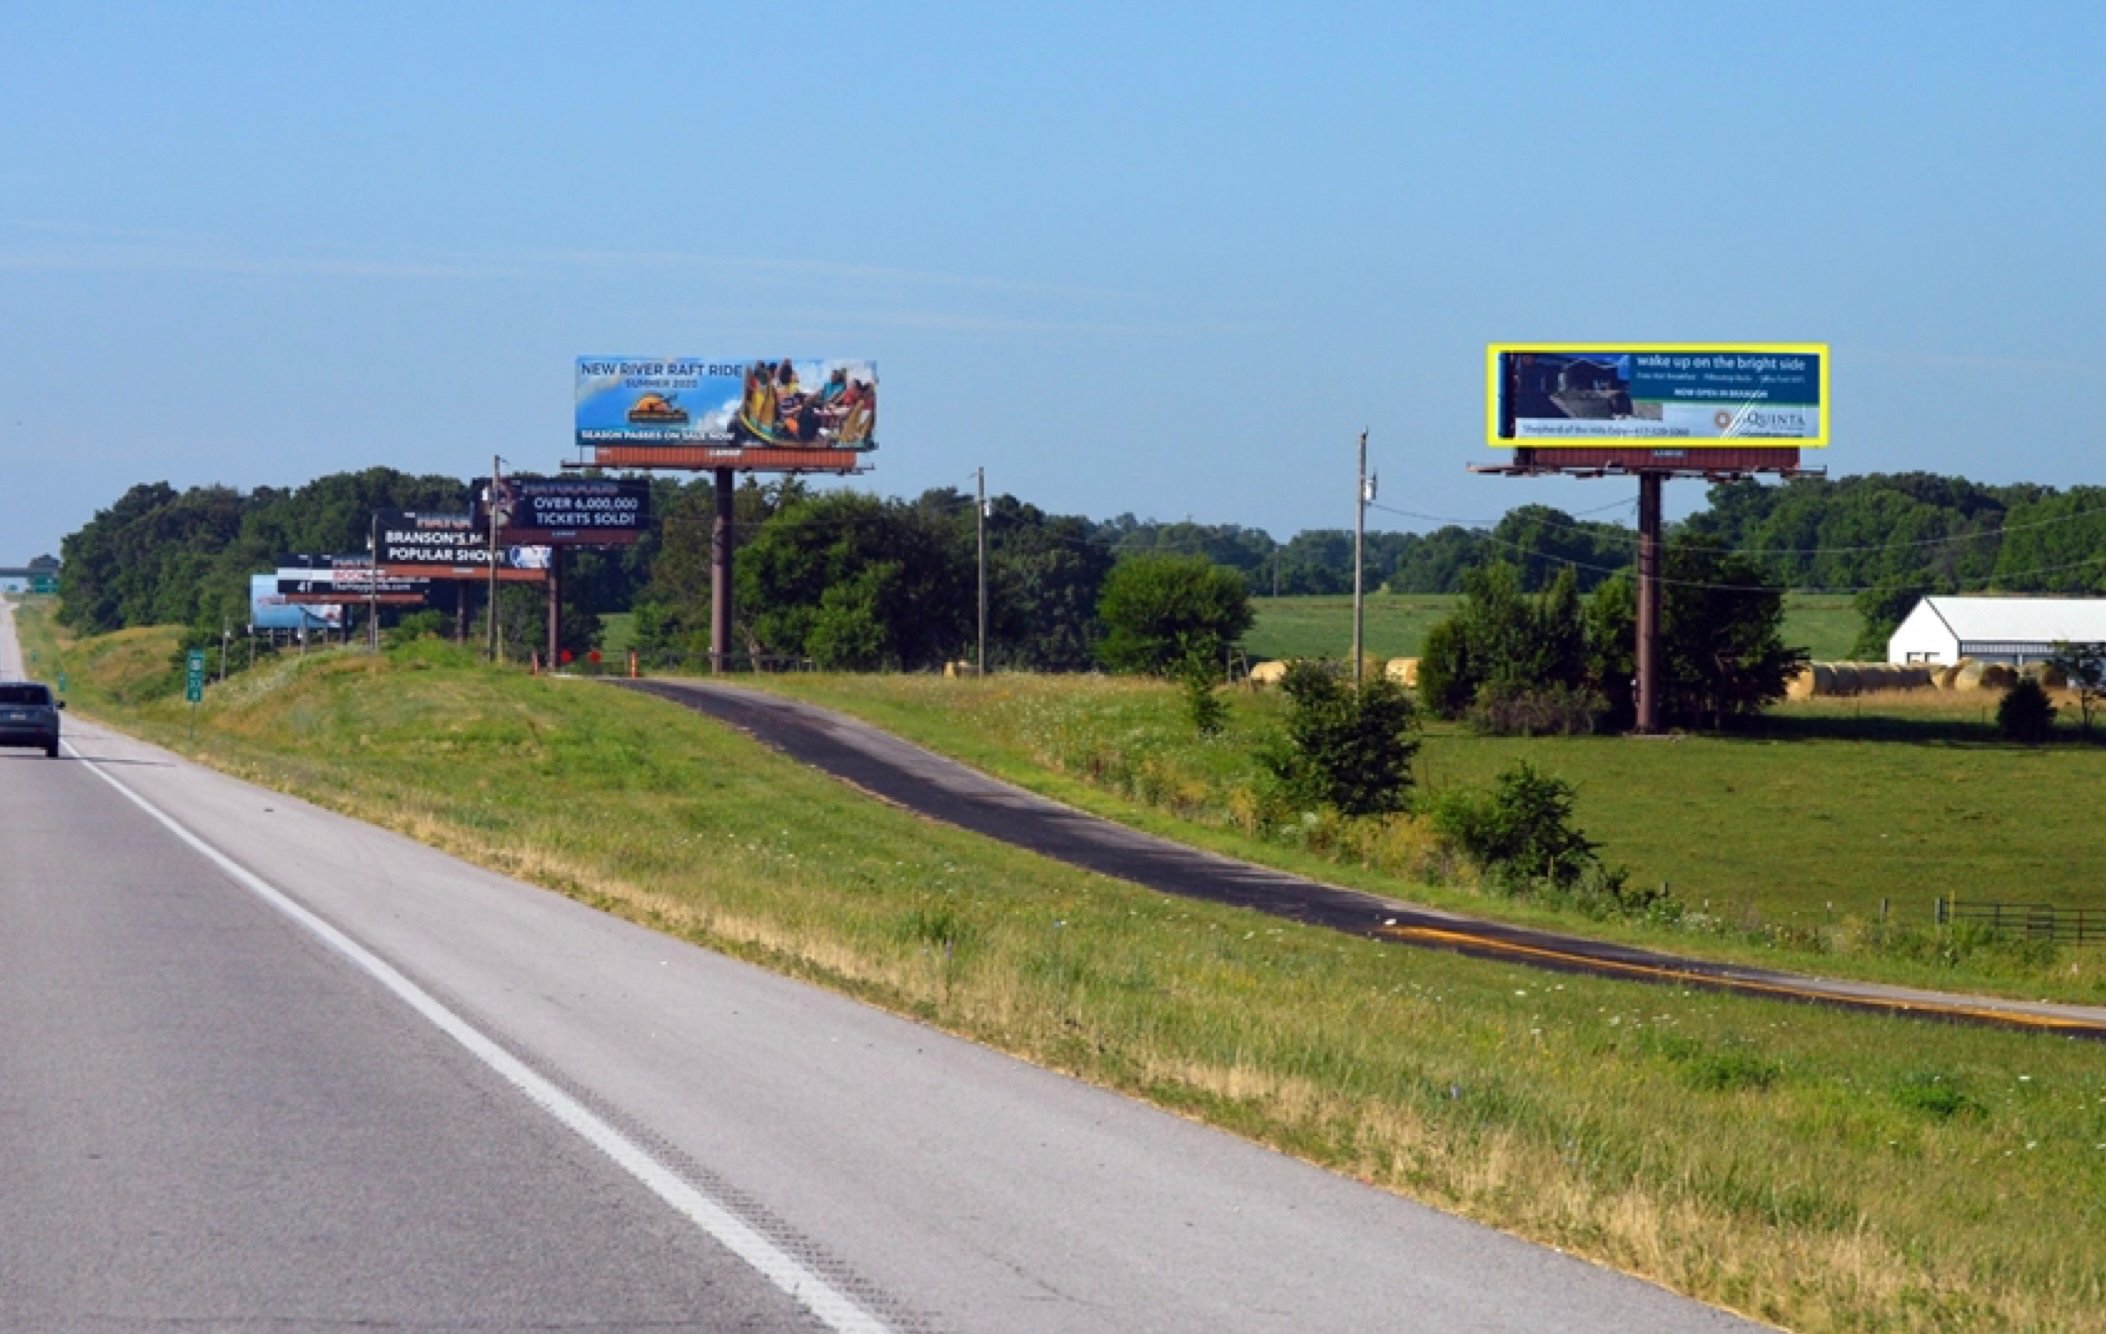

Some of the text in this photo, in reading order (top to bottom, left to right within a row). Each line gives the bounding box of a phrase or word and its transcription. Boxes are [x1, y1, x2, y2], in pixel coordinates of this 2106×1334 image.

[581, 362, 743, 378] NEW RIVER RAFT RIDE
[1636, 354, 1806, 372] wake up on the bright side
[624, 379, 670, 389] SUMMER
[1674, 388, 1694, 397] NOW
[1695, 388, 1718, 397] OPEN
[1719, 388, 1729, 397] IN
[581, 429, 623, 439] SEASON
[664, 431, 681, 440] ON
[534, 496, 639, 511] OVER 6,000,000
[536, 511, 636, 526] TICKETS SOLD!
[385, 530, 467, 544] BRANSON'S
[388, 546, 454, 561] POPULAR
